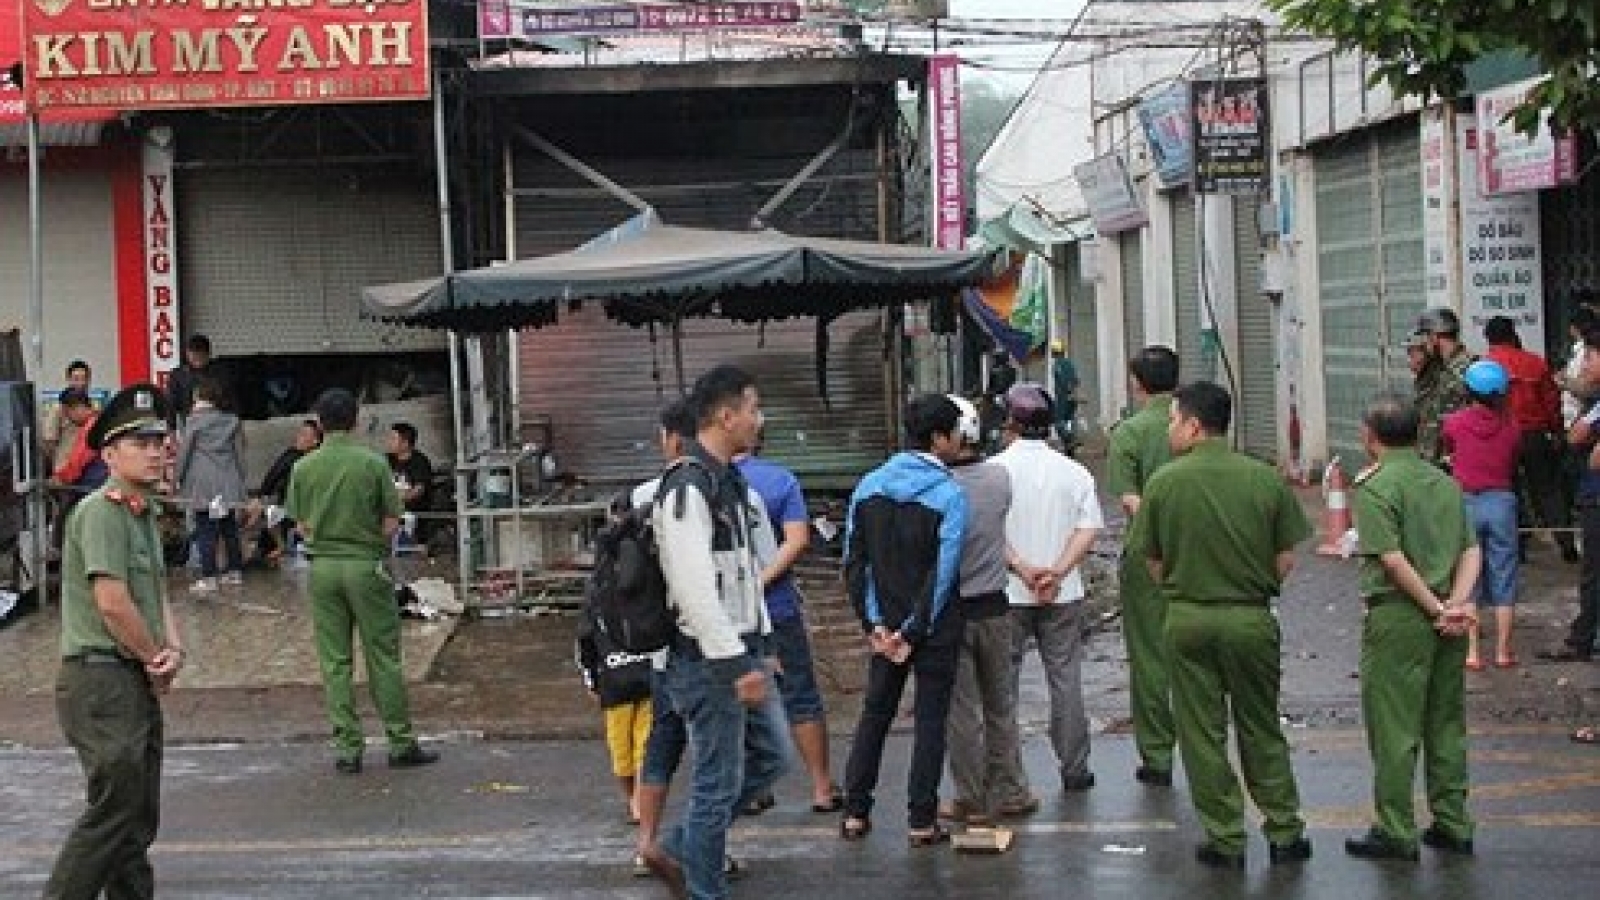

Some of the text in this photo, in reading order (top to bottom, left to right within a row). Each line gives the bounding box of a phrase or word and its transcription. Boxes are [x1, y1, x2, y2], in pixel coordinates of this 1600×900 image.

[33, 15, 414, 79] KIM MỸ ANH
